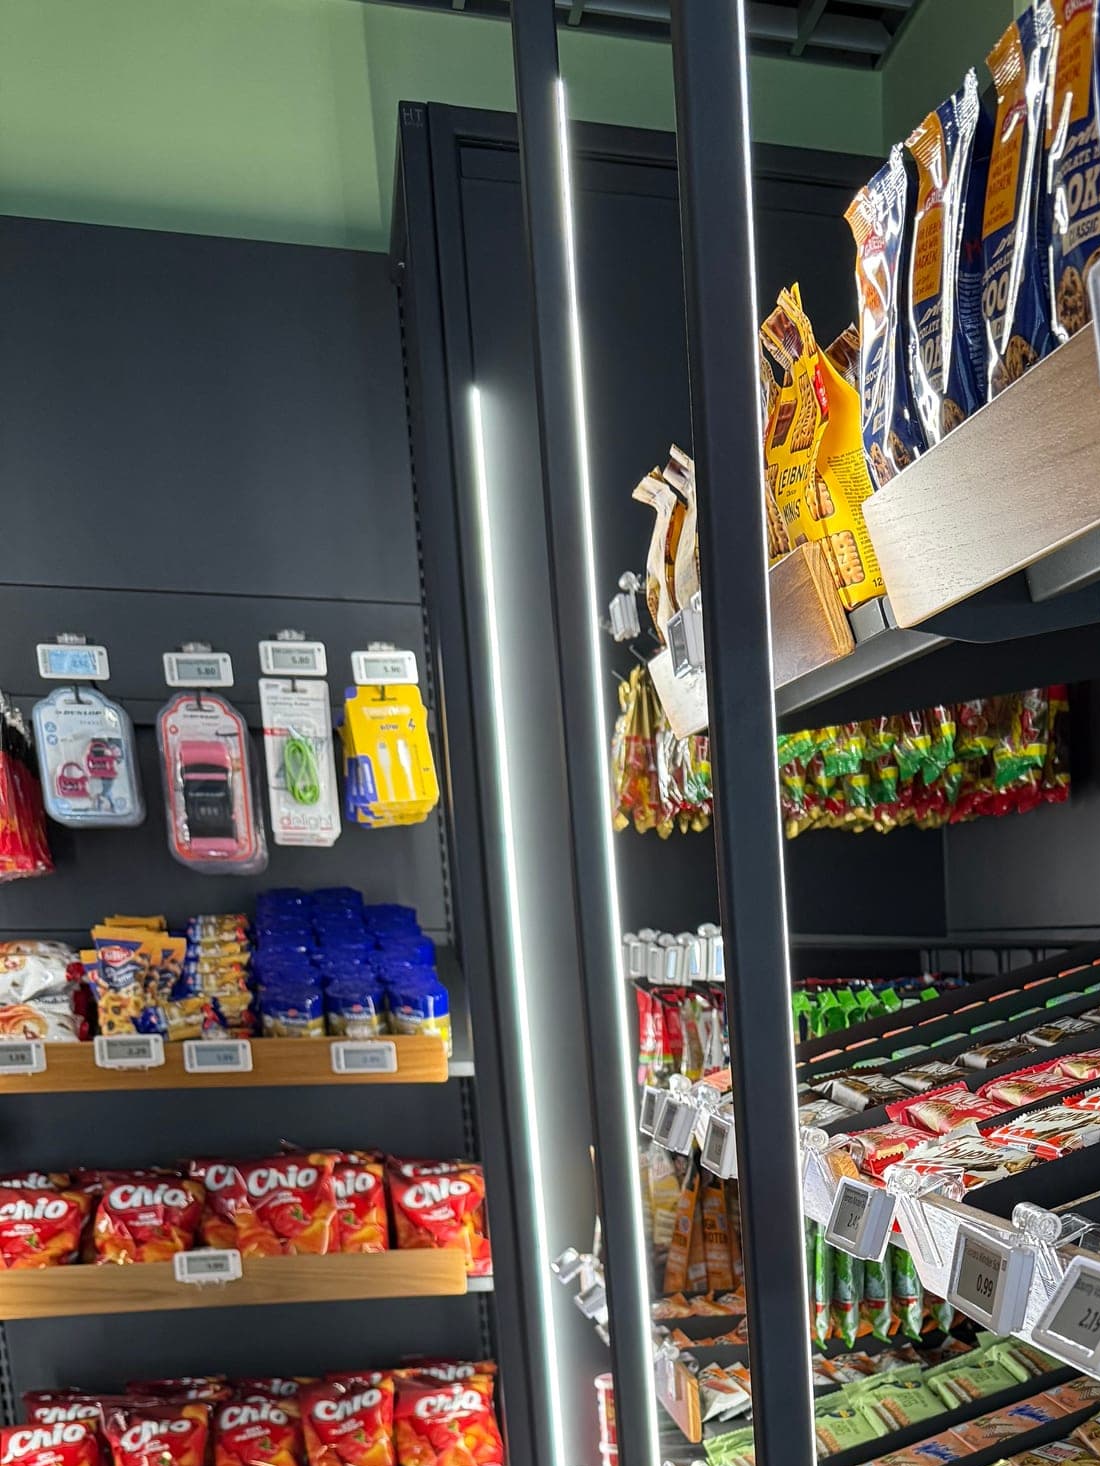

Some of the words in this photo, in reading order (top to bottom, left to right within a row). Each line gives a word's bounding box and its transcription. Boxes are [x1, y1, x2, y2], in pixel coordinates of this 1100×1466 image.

[108, 1183, 188, 1210] Chio
[248, 1163, 318, 1198] Chio
[403, 1176, 471, 1210] Chio
[976, 1273, 994, 1298] 0.99
[220, 1402, 288, 1431] Chio
[312, 1388, 383, 1422] Chio
[413, 1384, 484, 1420] Chio
[6, 1421, 87, 1460] Chio
[120, 1419, 192, 1452] Chio
